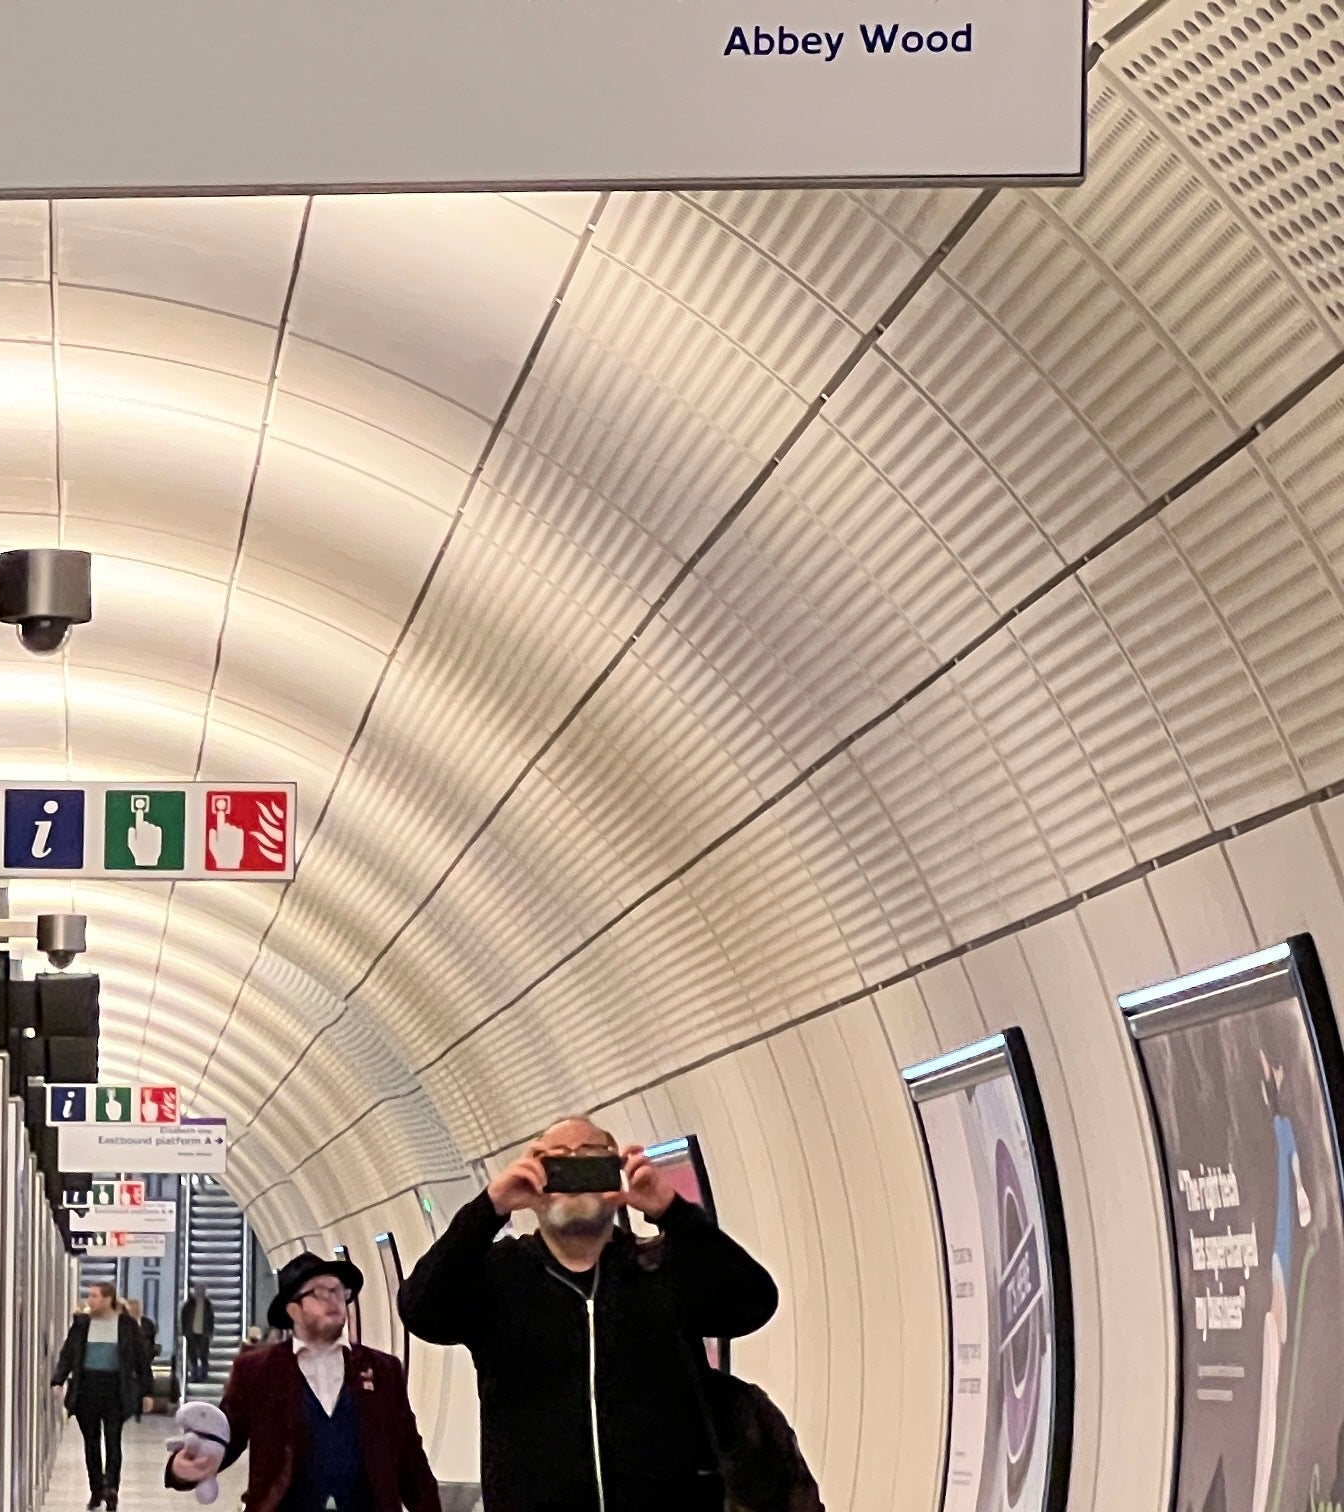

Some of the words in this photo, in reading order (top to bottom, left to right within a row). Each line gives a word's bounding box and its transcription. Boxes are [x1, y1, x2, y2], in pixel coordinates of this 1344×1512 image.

[723, 25, 844, 62] Abbey
[859, 23, 973, 54] Wood
[98, 1135, 152, 1145] Eastbound
[155, 1136, 201, 1147] platform
[204, 1136, 212, 1145] A
